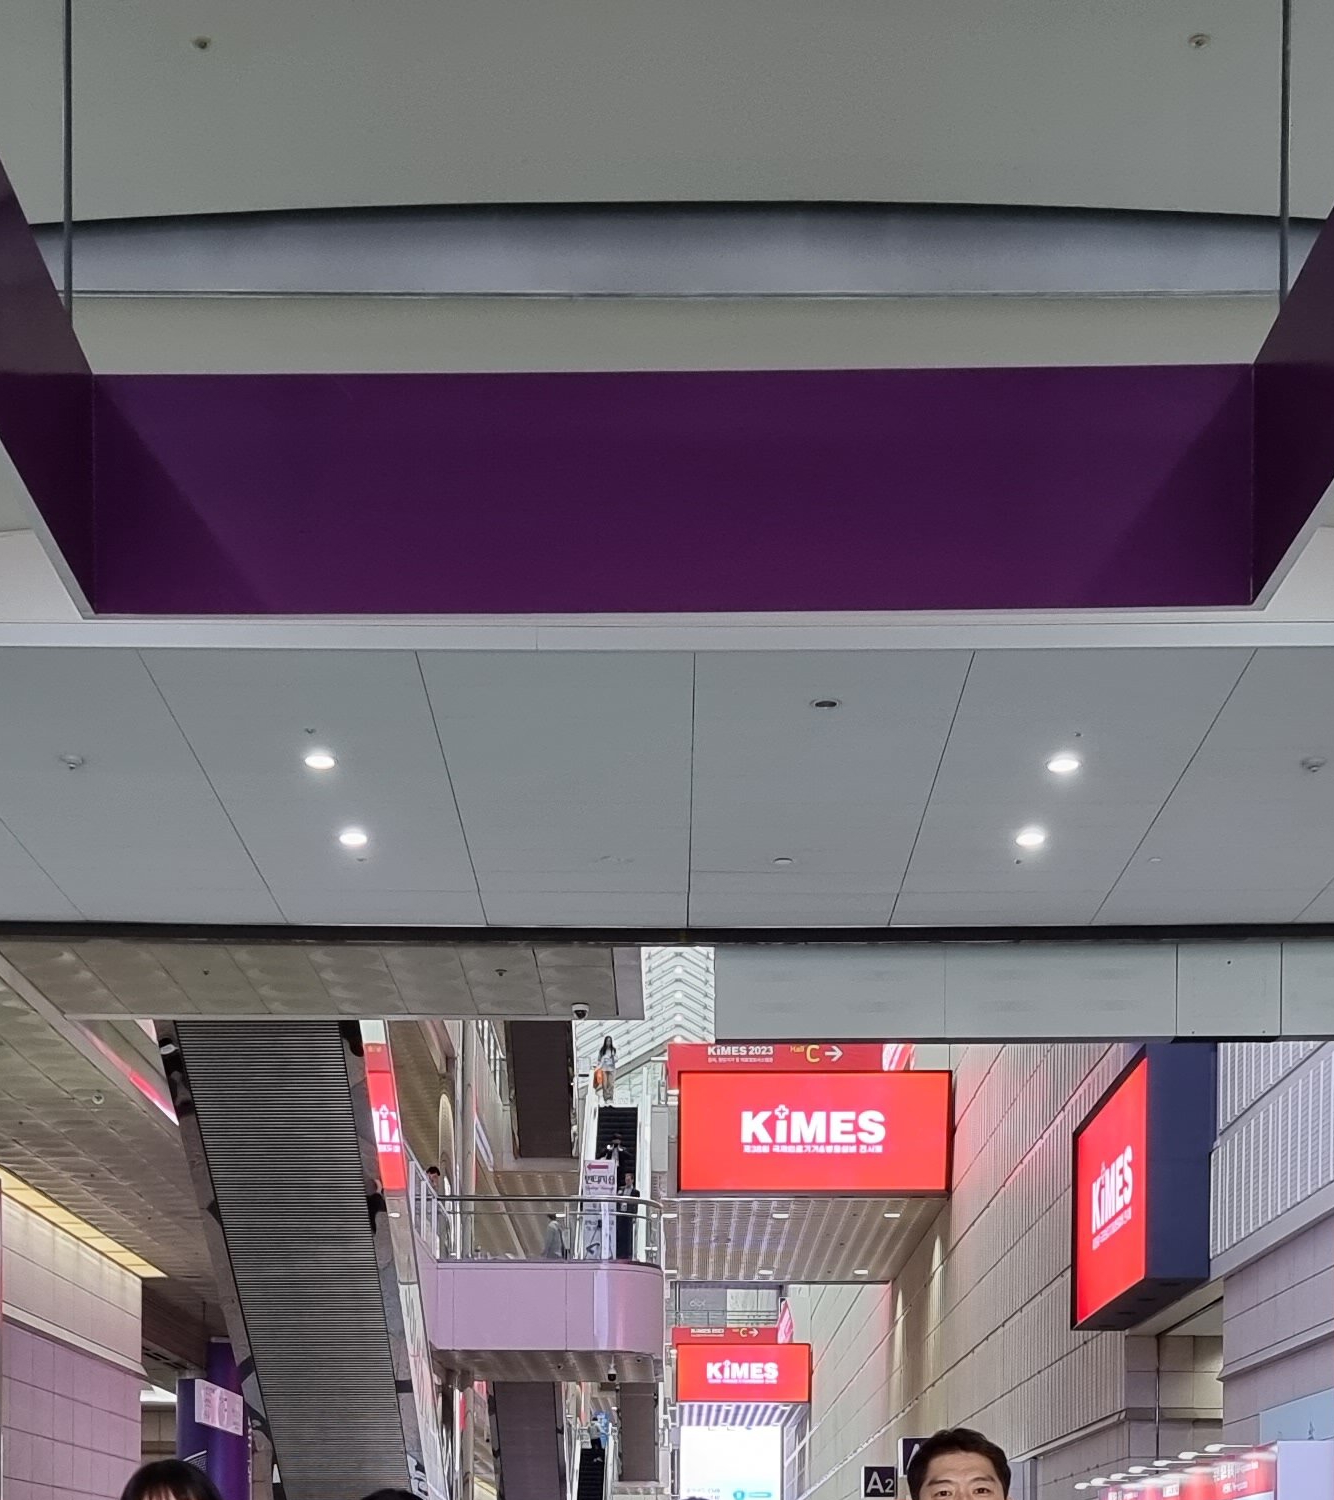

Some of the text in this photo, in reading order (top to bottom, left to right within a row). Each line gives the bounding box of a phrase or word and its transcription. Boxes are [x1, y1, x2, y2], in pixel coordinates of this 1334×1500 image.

[748, 1045, 774, 1056] 2023
[805, 1044, 821, 1063] C
[866, 1471, 895, 1493] A2
